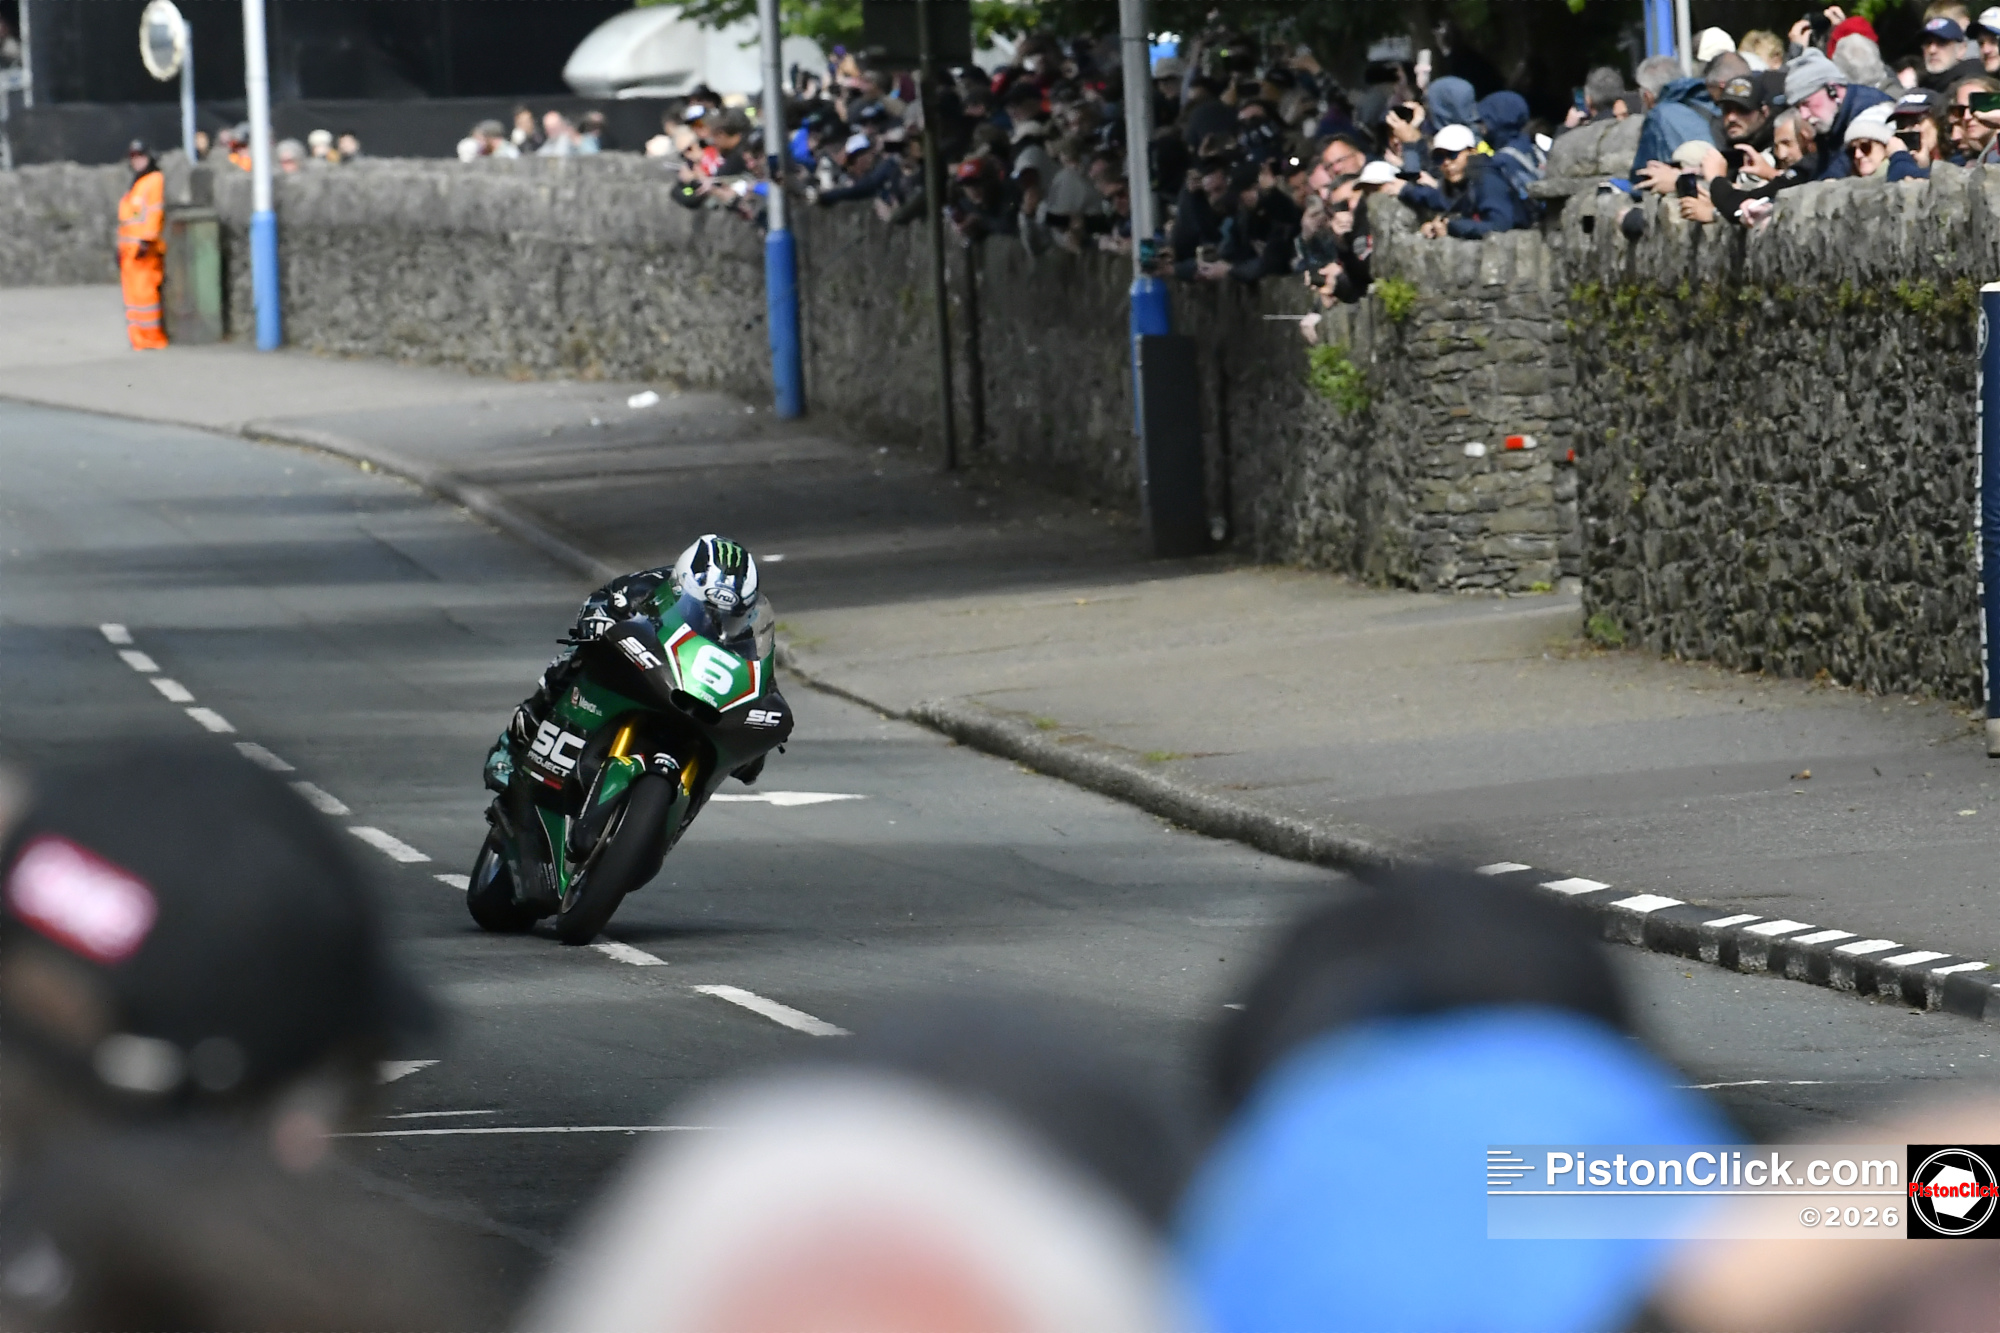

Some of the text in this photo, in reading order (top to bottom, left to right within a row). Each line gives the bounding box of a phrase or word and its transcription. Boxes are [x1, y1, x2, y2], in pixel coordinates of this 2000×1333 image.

[621, 637, 662, 668] SC
[691, 645, 741, 695] 6
[746, 709, 782, 724] SC
[531, 720, 586, 770] SC
[527, 750, 570, 777] PROJECT
